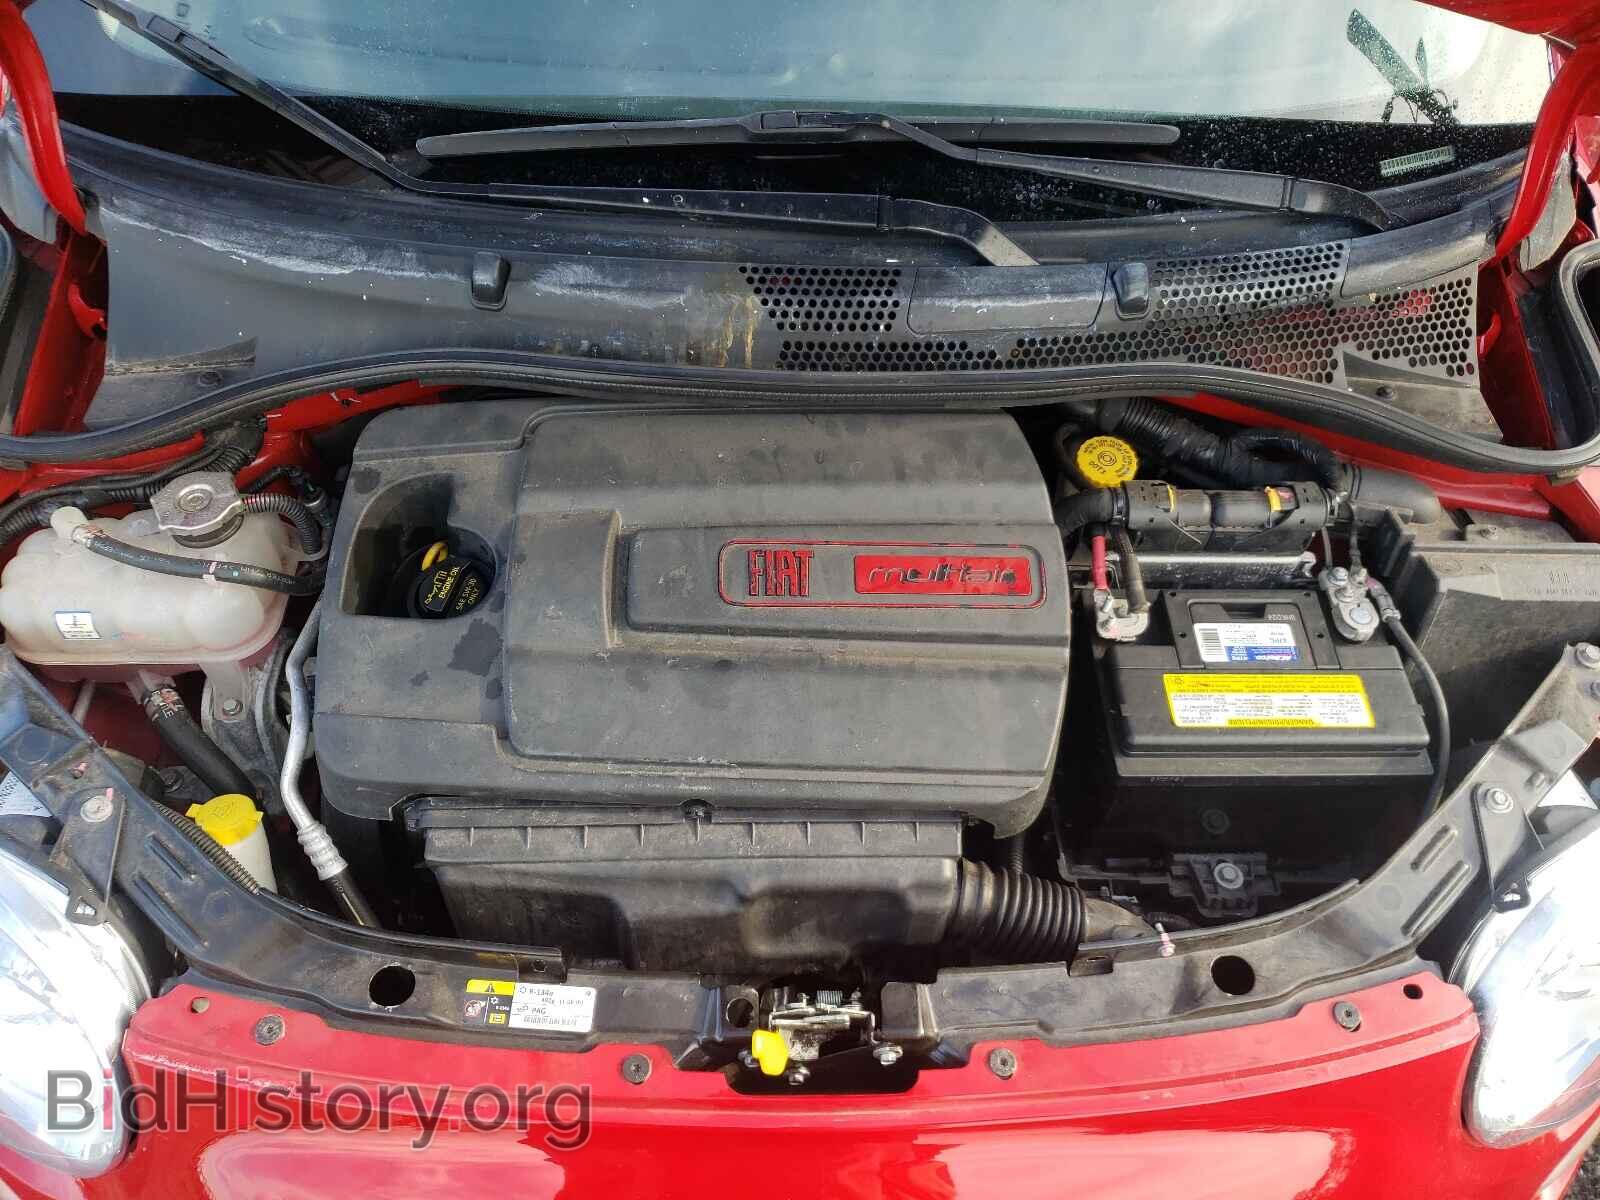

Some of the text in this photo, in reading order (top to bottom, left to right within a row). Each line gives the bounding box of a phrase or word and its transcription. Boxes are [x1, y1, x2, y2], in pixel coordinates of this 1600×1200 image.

[439, 567, 460, 599] ENGINE OIL
[748, 550, 814, 597] FIAT
[867, 560, 1017, 585] multiair
